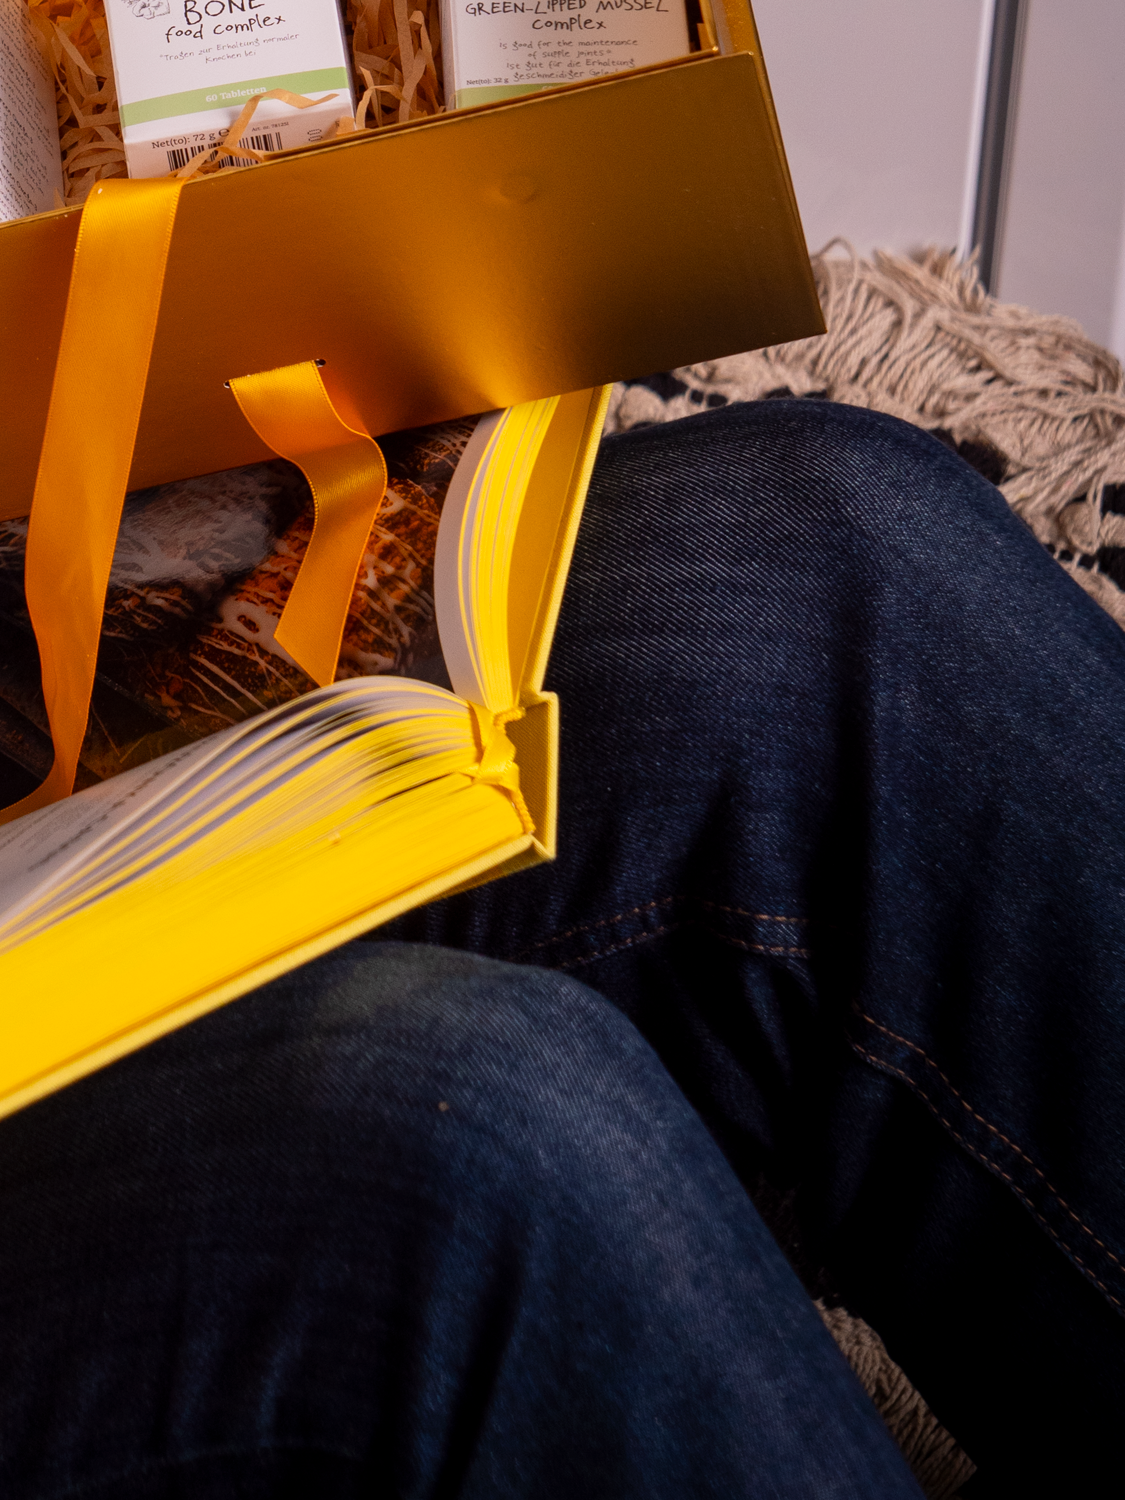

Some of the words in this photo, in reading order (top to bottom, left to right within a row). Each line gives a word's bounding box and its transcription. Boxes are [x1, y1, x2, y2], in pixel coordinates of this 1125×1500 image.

[165, 24, 204, 44] food
[213, 13, 286, 36] complex
[205, 93, 218, 103] 60
[220, 86, 267, 101] Tabletten
[151, 134, 191, 149] Net(to):
[193, 131, 206, 141] 72
[209, 131, 216, 141] g
